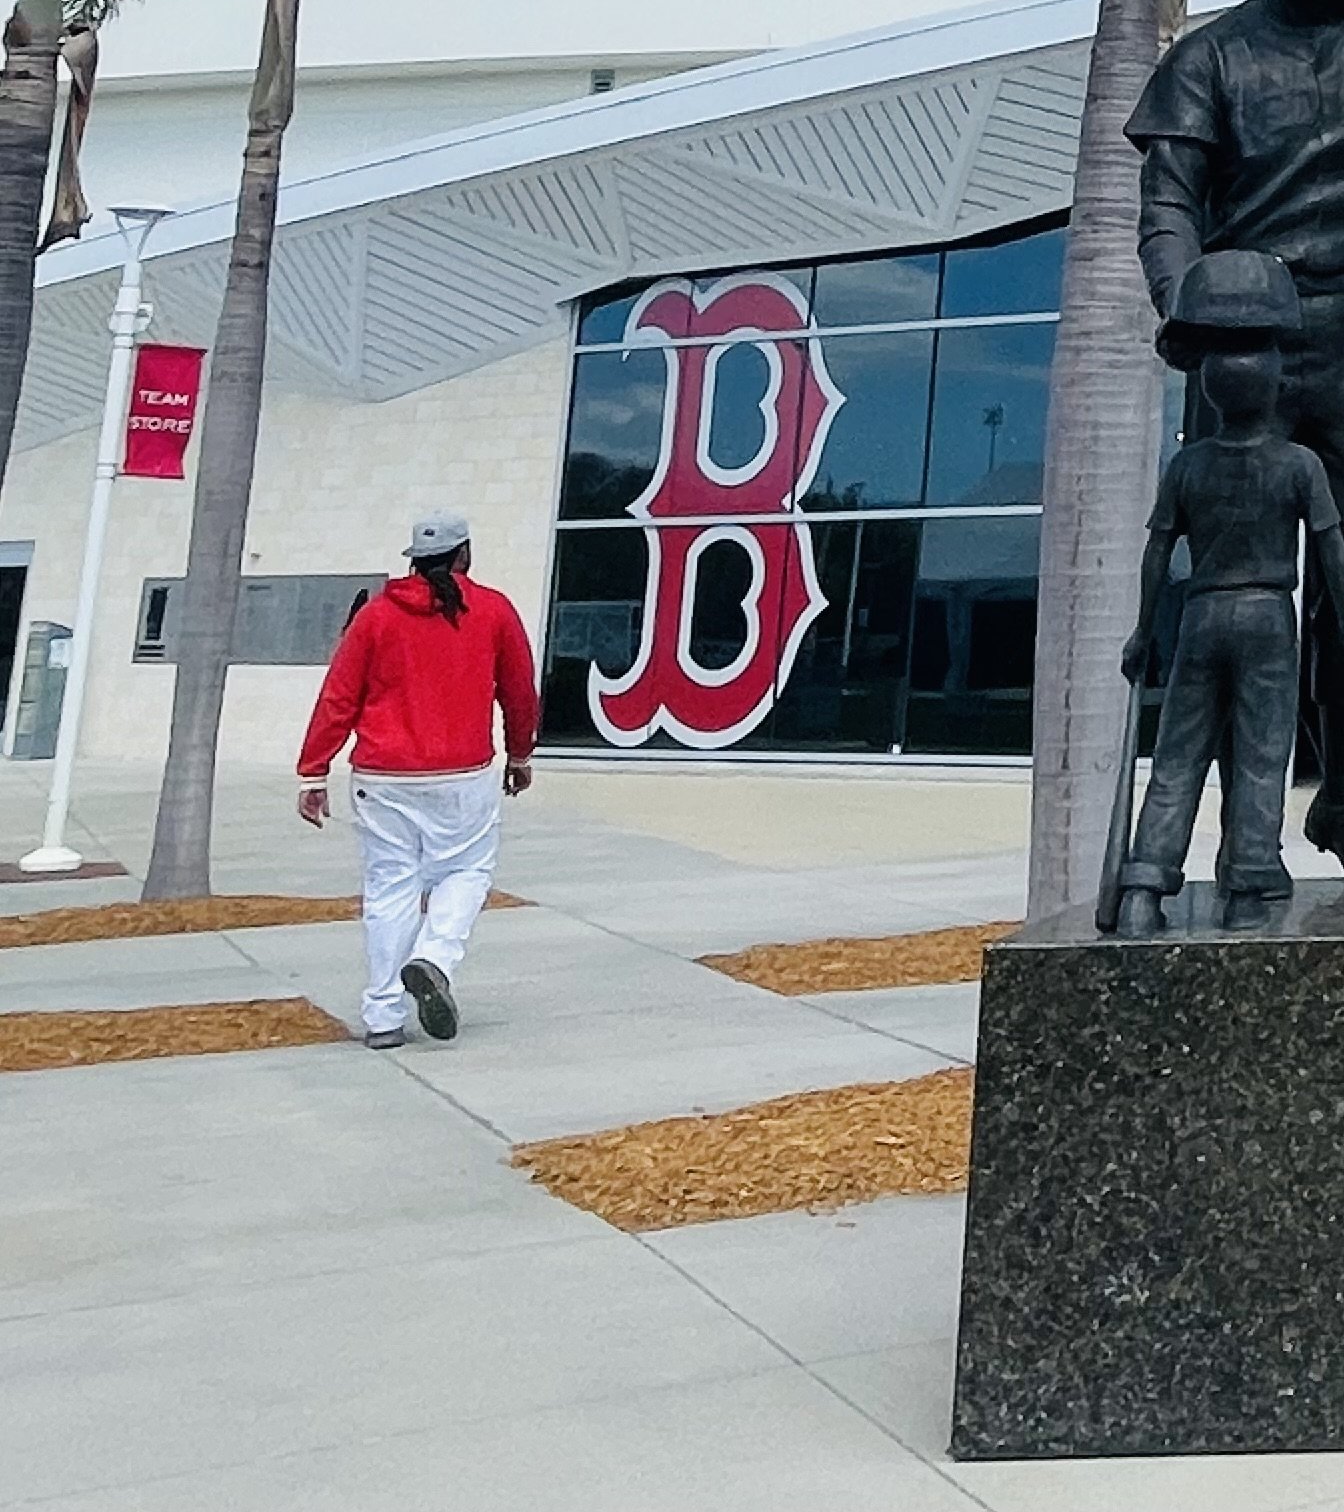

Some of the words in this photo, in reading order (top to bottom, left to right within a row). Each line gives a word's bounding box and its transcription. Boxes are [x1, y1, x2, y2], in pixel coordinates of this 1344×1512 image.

[138, 390, 190, 406] TEAM
[128, 416, 192, 434] STORE
[588, 271, 847, 750] B
